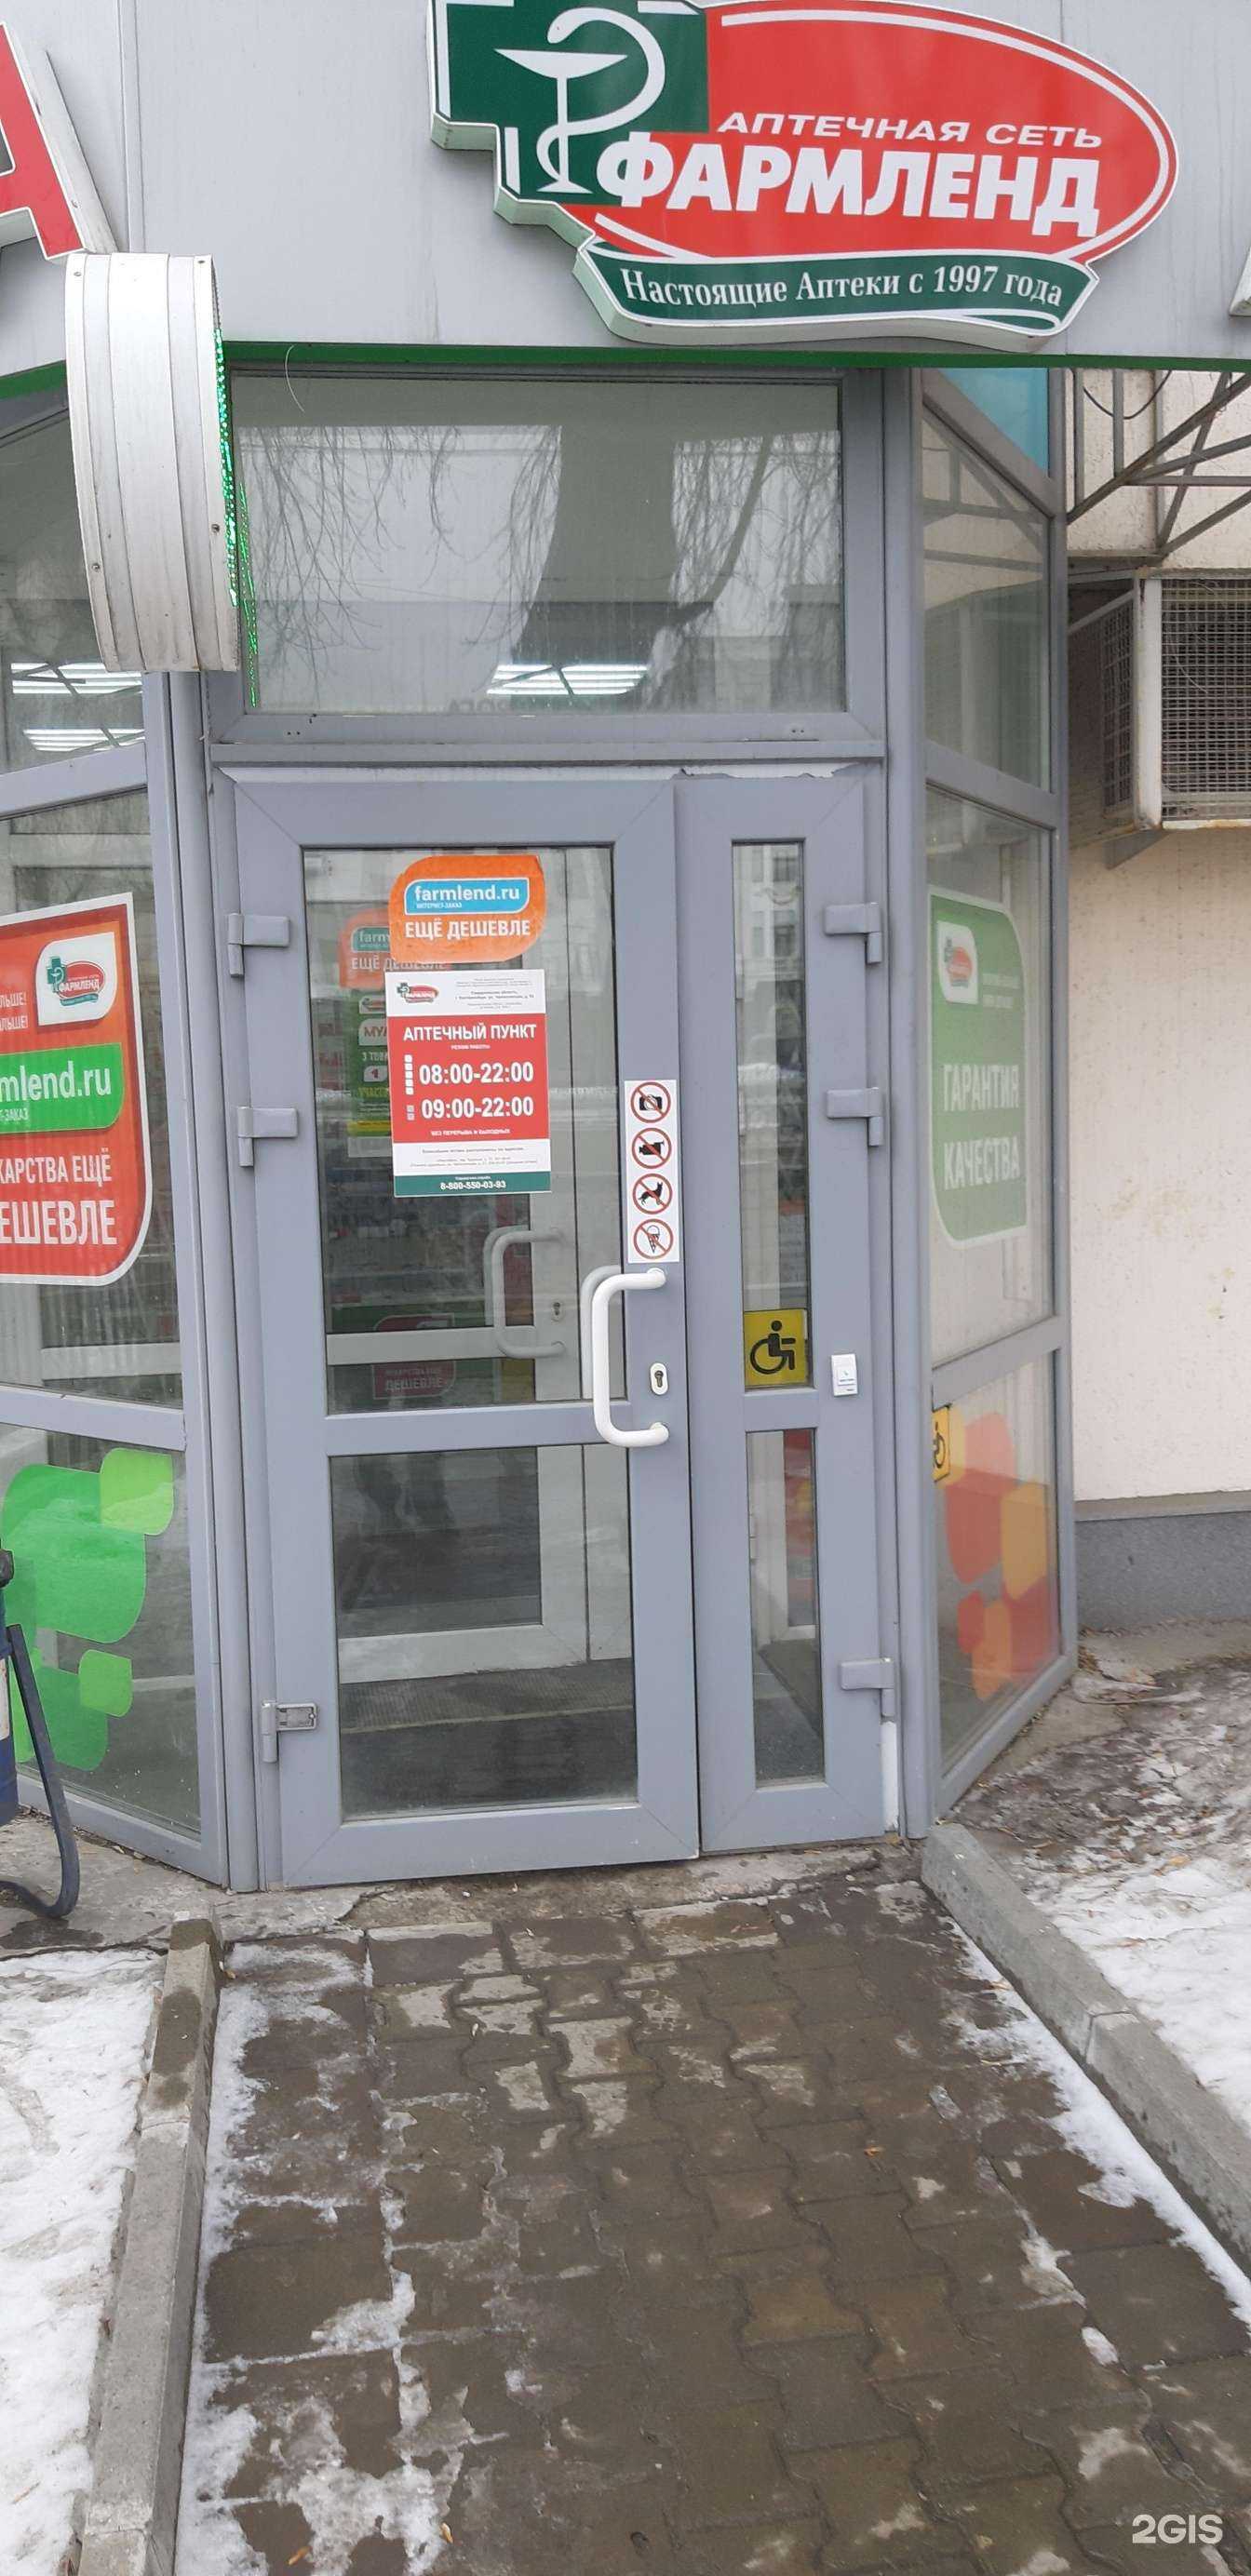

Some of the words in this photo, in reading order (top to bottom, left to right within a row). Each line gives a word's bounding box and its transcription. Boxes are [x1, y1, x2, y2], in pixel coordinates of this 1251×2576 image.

[718, 113, 970, 142] АПТЕЧНАЯ
[986, 123, 1102, 149] СЕТЬ
[597, 131, 1100, 237] ФАРМЛЕНД
[619, 268, 787, 306] Настоящие
[795, 271, 900, 302] Аптеки
[908, 272, 923, 294] с
[934, 265, 998, 293] 1997
[1003, 275, 1063, 307] года
[414, 884, 519, 901] farmlend.ru
[405, 918, 443, 940] ЕЩЁ
[447, 919, 531, 940] ДЕШЕВЛЕ
[0, 1014, 28, 1031] ЛЬШЕ!
[403, 1022, 487, 1041] АПТЕЧНЫЙ
[491, 1024, 536, 1040] ПУНКТ
[419, 1061, 534, 1084] 08:00-22:00
[944, 1064, 1019, 1111] ГАРАНТИЯ
[421, 1096, 534, 1119] 09:00-22:00
[72, 1147, 112, 1187] ЕЩЁ
[944, 1135, 1020, 1190] КАЧЕСТВА
[0, 1200, 117, 1245] ЕШЕВЛЕ
